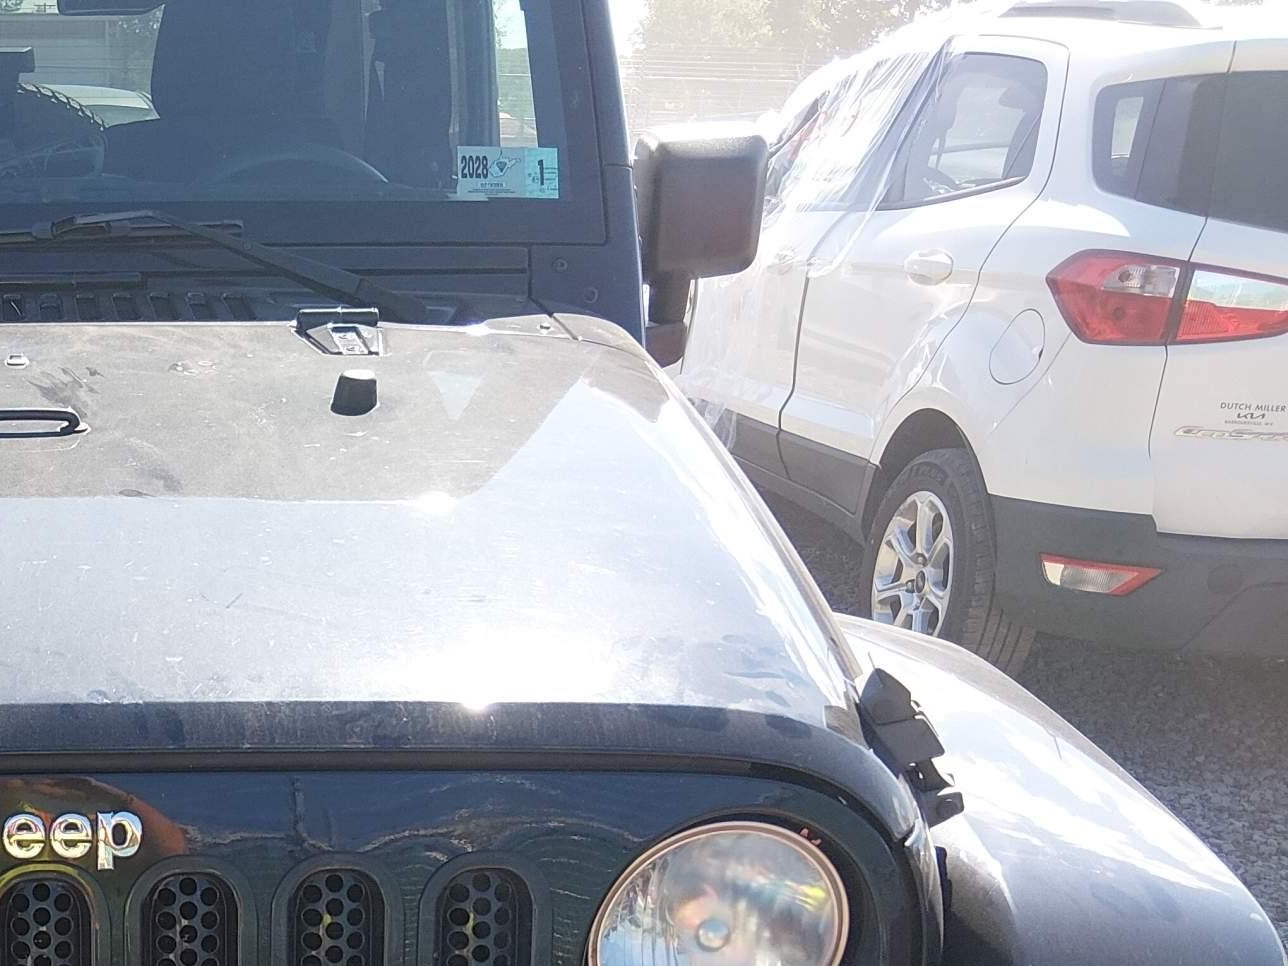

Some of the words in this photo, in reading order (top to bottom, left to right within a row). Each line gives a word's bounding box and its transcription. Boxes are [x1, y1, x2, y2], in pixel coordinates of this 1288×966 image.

[461, 155, 489, 179] 2028
[537, 159, 545, 186] 1
[1220, 401, 1252, 411] DUTCH
[1255, 403, 1287, 413] MILLER
